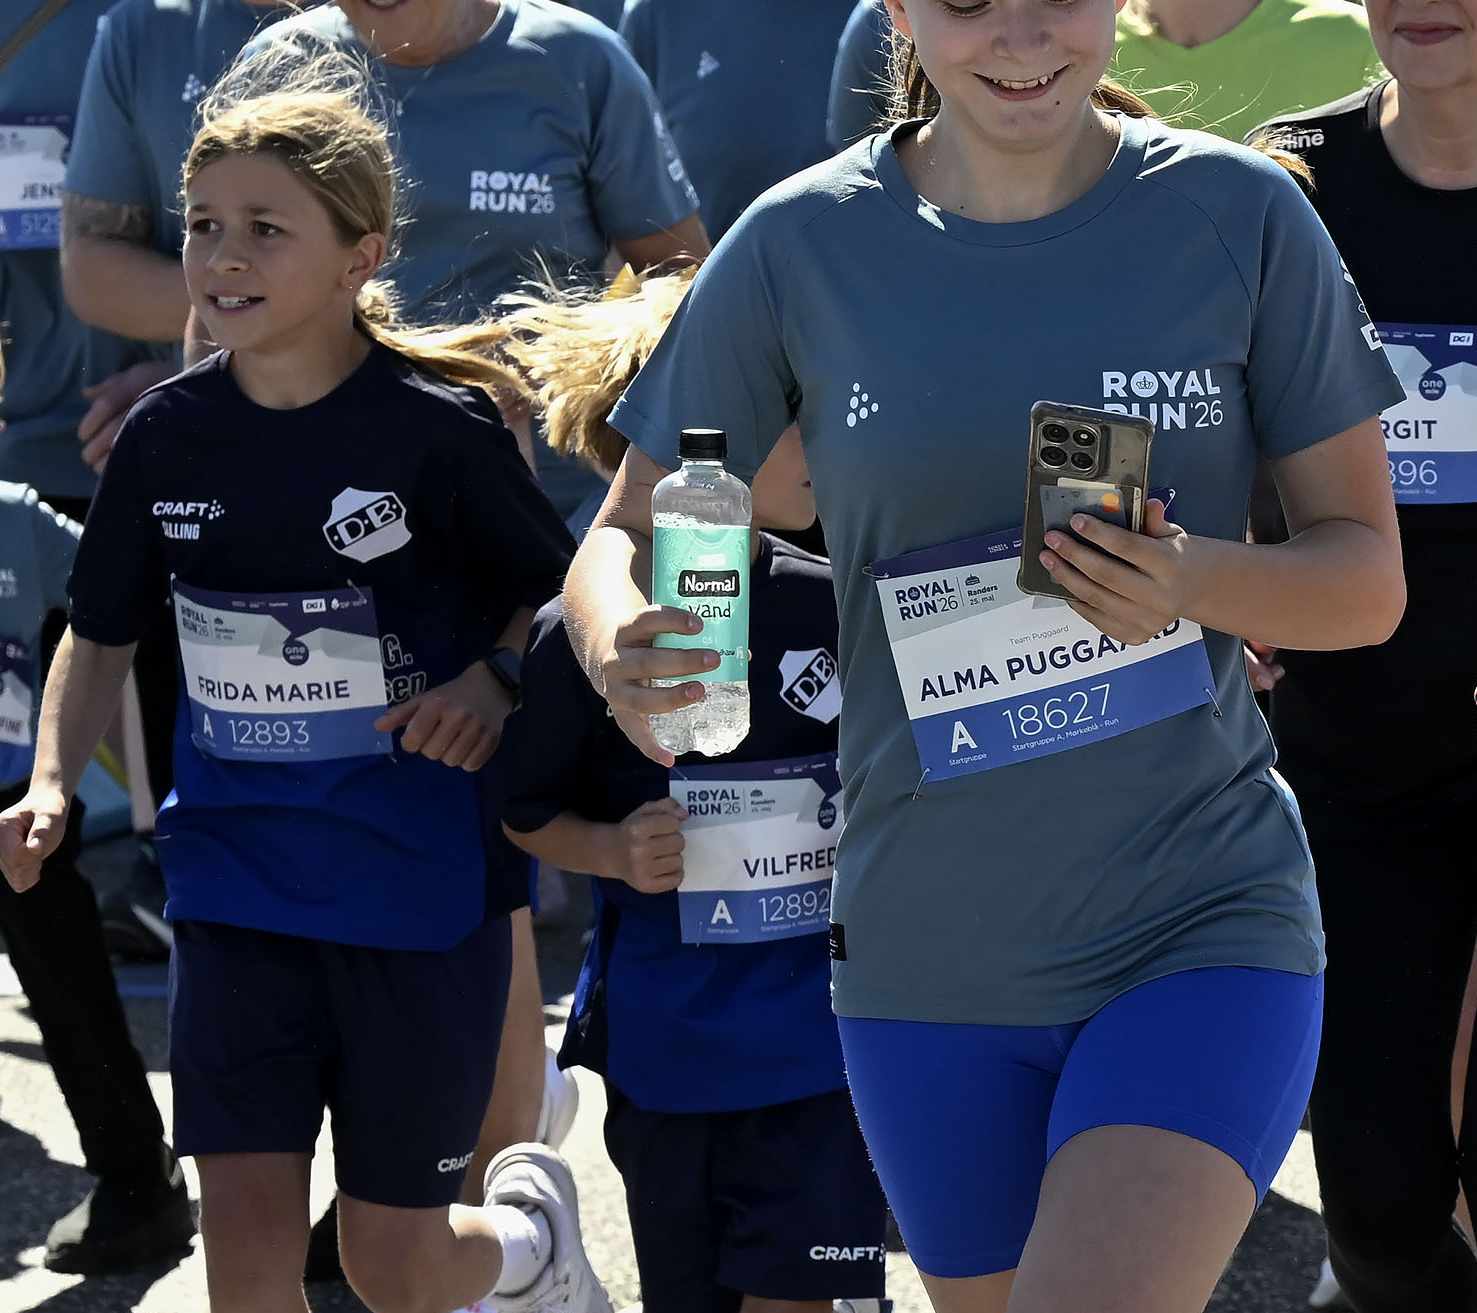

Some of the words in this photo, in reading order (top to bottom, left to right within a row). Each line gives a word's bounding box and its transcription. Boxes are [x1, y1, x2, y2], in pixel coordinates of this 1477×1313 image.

[469, 169, 552, 194] ROYAL
[1102, 368, 1221, 399] ROYAL
[1421, 379, 1443, 389] one
[152, 501, 209, 517] CRAFT
[684, 573, 736, 592] Normal
[895, 579, 955, 605] ROYAL
[967, 584, 999, 598] Randers
[688, 600, 732, 619] vand
[1010, 636, 1031, 647] Team
[1032, 624, 1070, 643] Puggaard
[197, 675, 259, 702] FRIDA
[265, 679, 351, 702] MARIE
[920, 664, 999, 702] ALMA
[203, 712, 214, 739] A
[227, 719, 310, 745] 12893
[951, 720, 979, 754] A
[1002, 683, 1111, 740] 18627
[1012, 736, 1056, 753] Startgruppe
[1065, 724, 1100, 740] Mørkeblå
[1104, 718, 1119, 730] Run
[948, 752, 988, 766] Startgruppe
[687, 788, 740, 803] ROYAL
[743, 845, 836, 879] VILFRED
[711, 899, 733, 926] A
[758, 887, 830, 924] 12892
[809, 1245, 879, 1262] CRAFT
